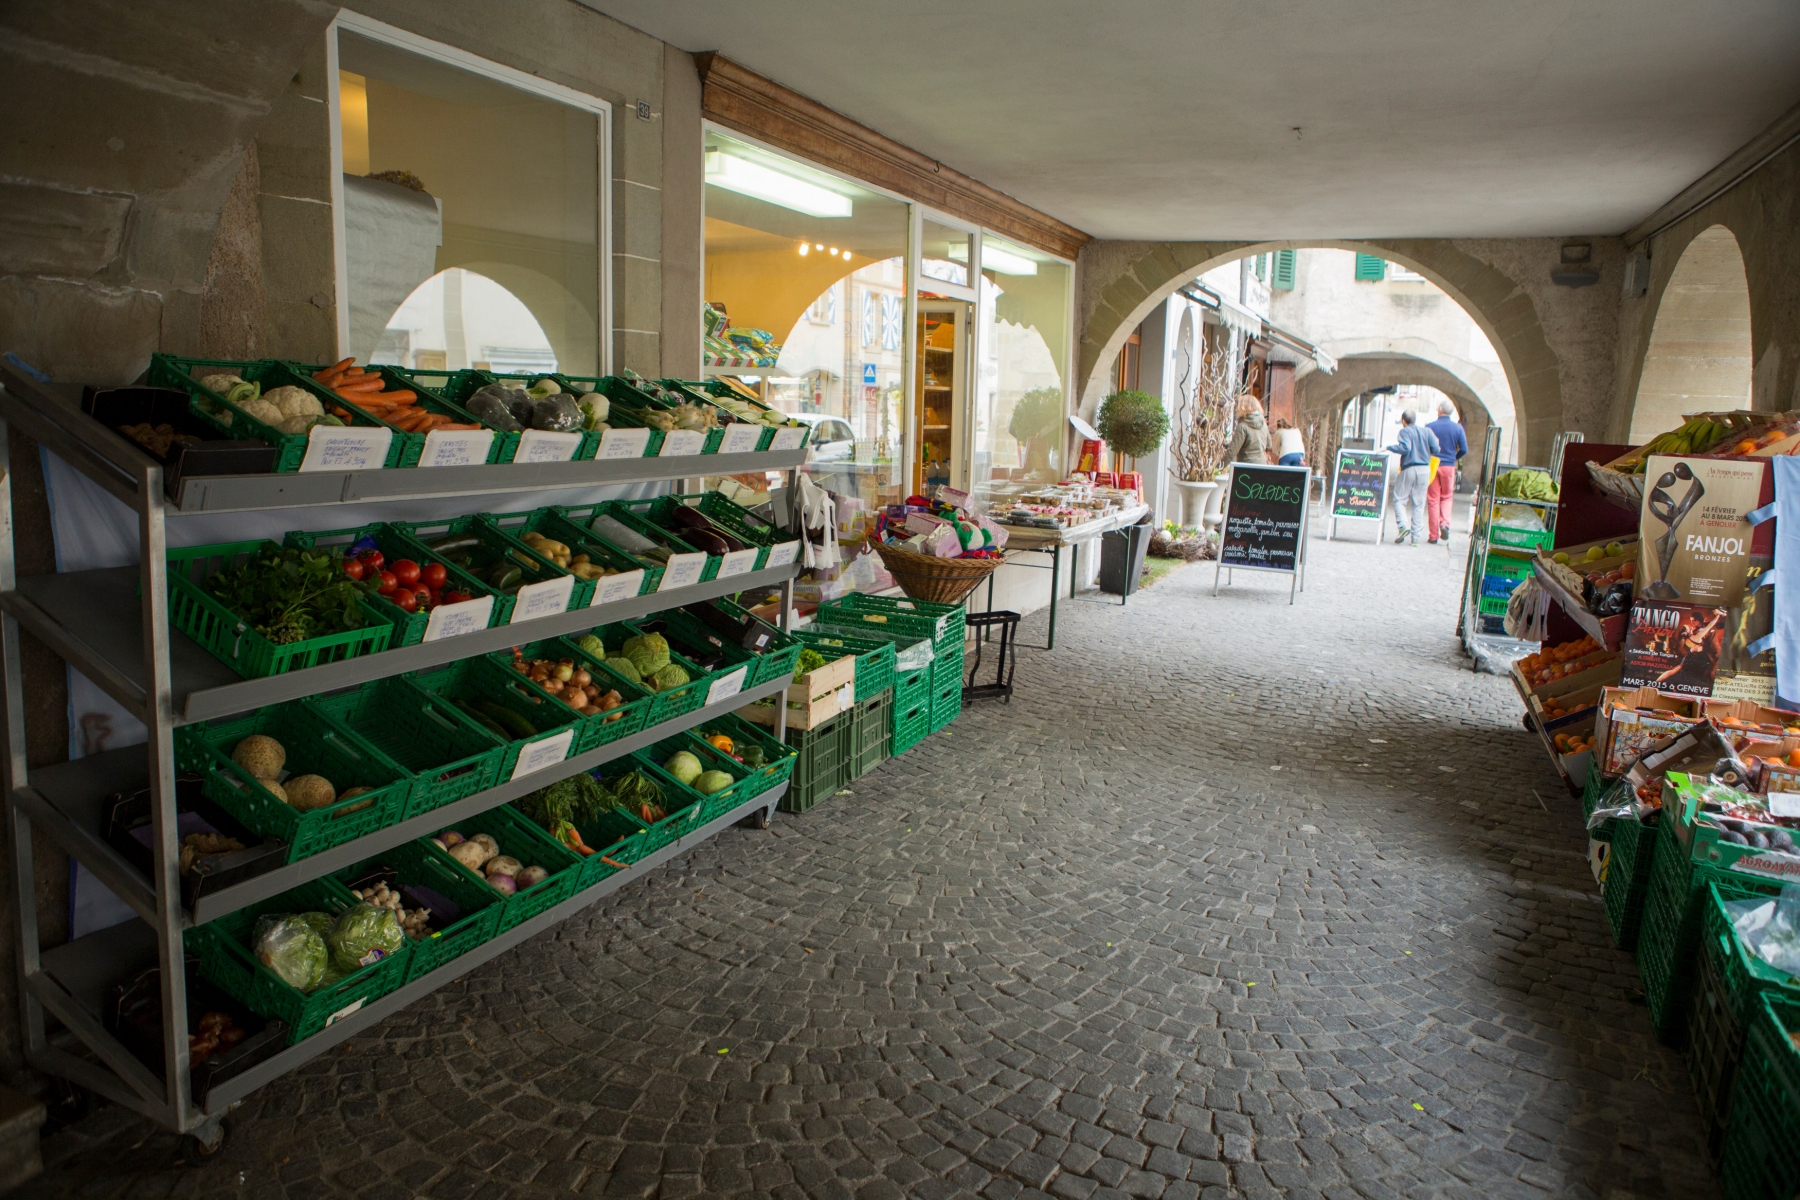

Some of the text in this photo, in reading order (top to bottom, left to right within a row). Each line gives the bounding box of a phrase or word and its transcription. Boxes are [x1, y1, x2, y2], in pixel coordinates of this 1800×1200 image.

[640, 104, 649, 118] 39
[1234, 474, 1300, 504] SALADES
[1350, 496, 1376, 507] Chocolat
[1711, 505, 1736, 514] FÉVRIER
[1685, 534, 1745, 556] FANJOL
[1694, 554, 1731, 563] BRONZES
[1633, 606, 1680, 630] TANGO
[1622, 677, 1644, 686] MARS
[1646, 680, 1667, 689] 2015
